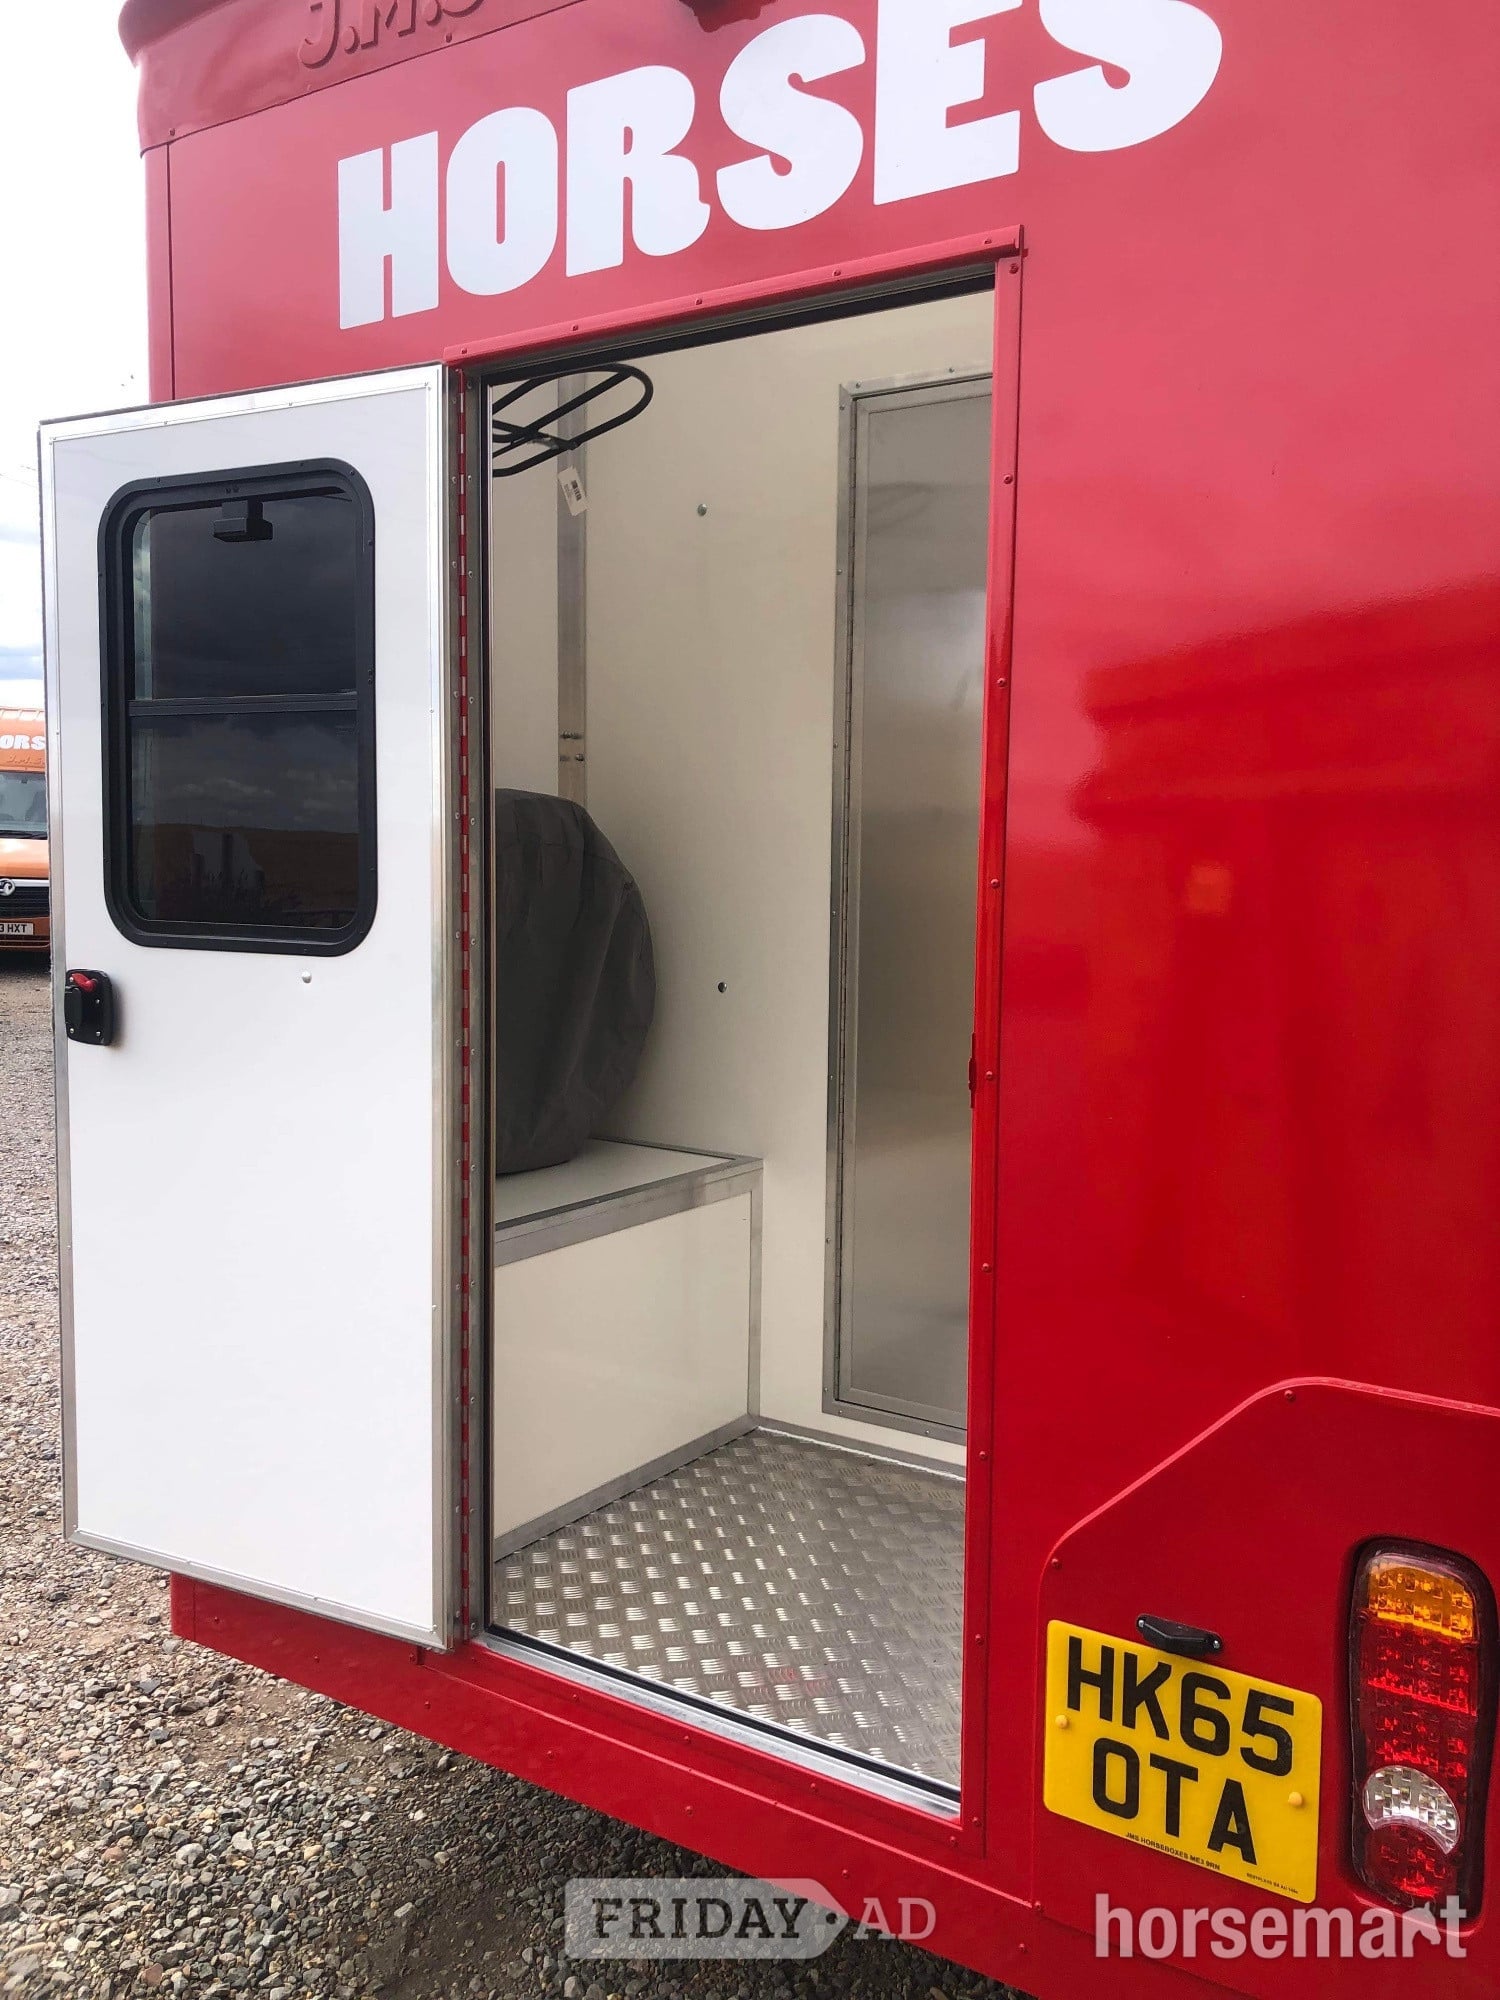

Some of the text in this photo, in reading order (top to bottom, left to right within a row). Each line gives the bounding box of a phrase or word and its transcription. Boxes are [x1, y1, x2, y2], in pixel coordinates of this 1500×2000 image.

[338, 0, 1222, 330] HORSES
[7, 924, 28, 933] HXT
[1067, 1635, 1295, 1777] HK65
[1092, 1737, 1258, 1866] OTA
[1126, 1832, 1140, 1842] JMS
[1140, 1837, 1189, 1860] HORSEBOXES
